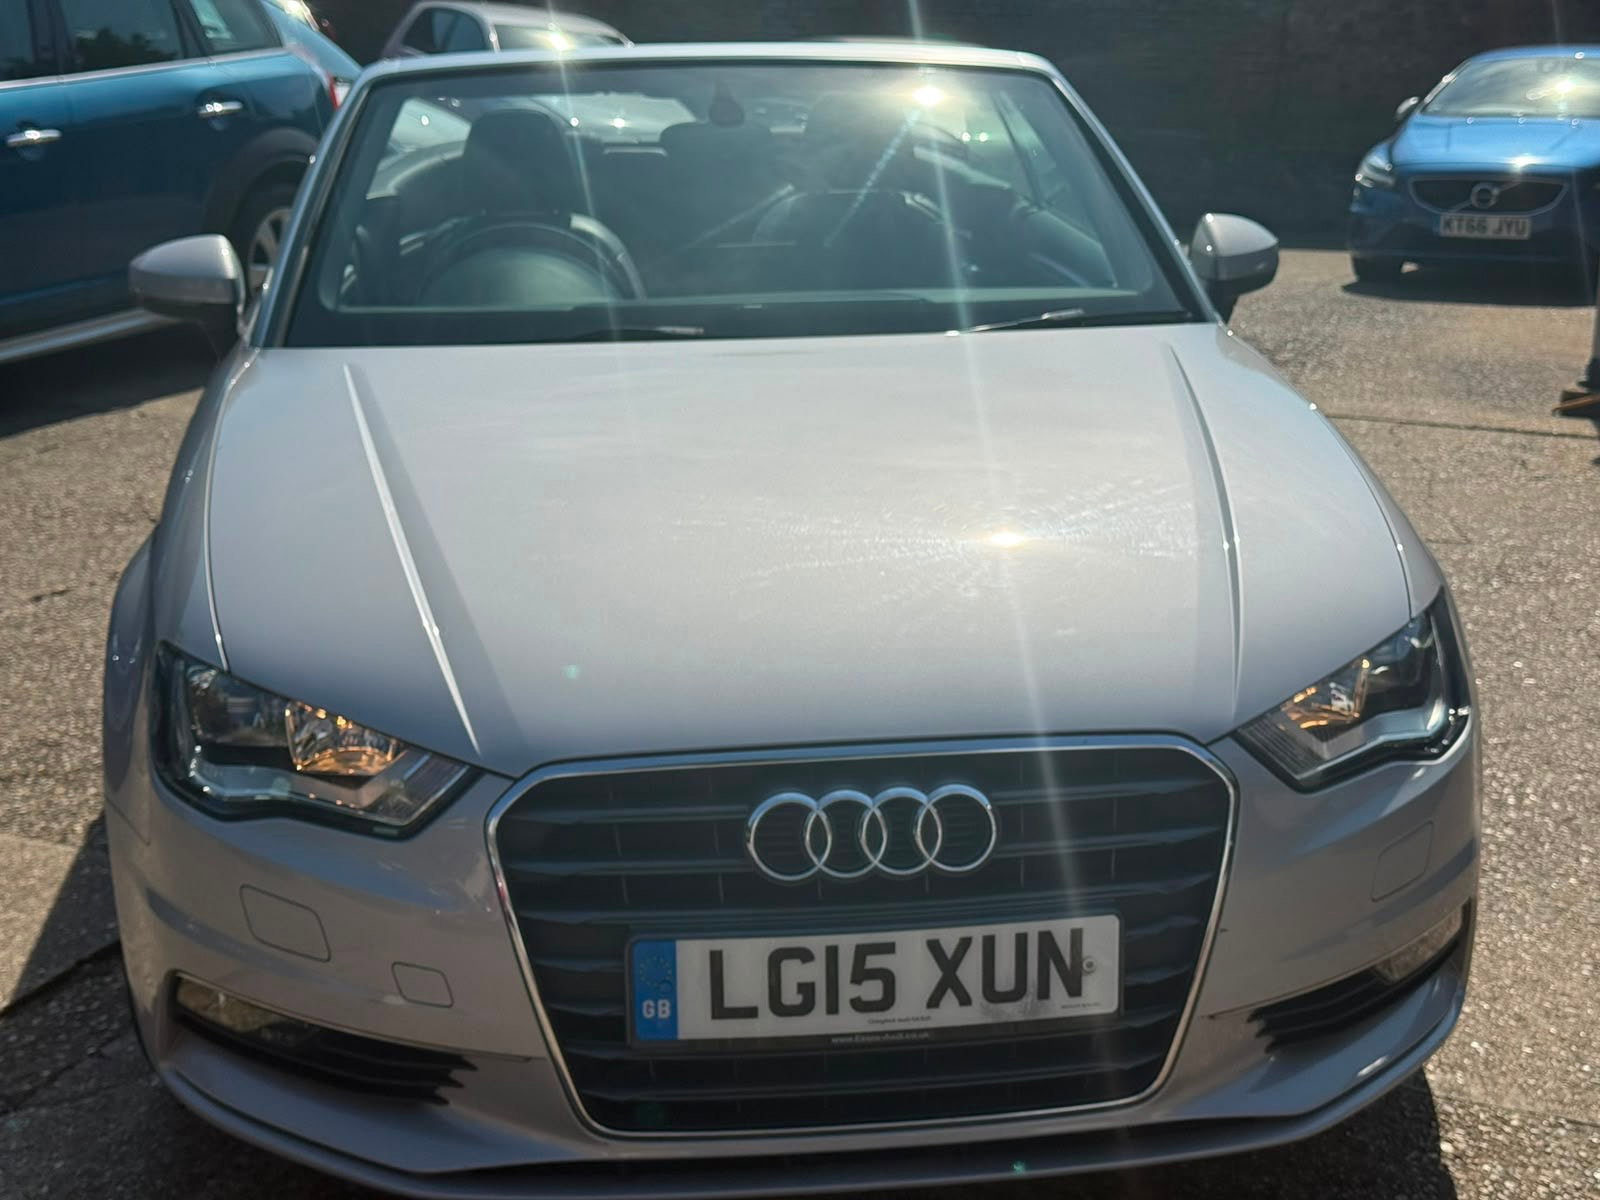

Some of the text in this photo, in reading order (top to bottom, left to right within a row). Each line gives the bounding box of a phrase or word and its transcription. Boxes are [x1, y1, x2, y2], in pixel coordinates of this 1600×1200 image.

[710, 928, 1083, 1020] LG15 XUN
[642, 999, 671, 1019] GB
